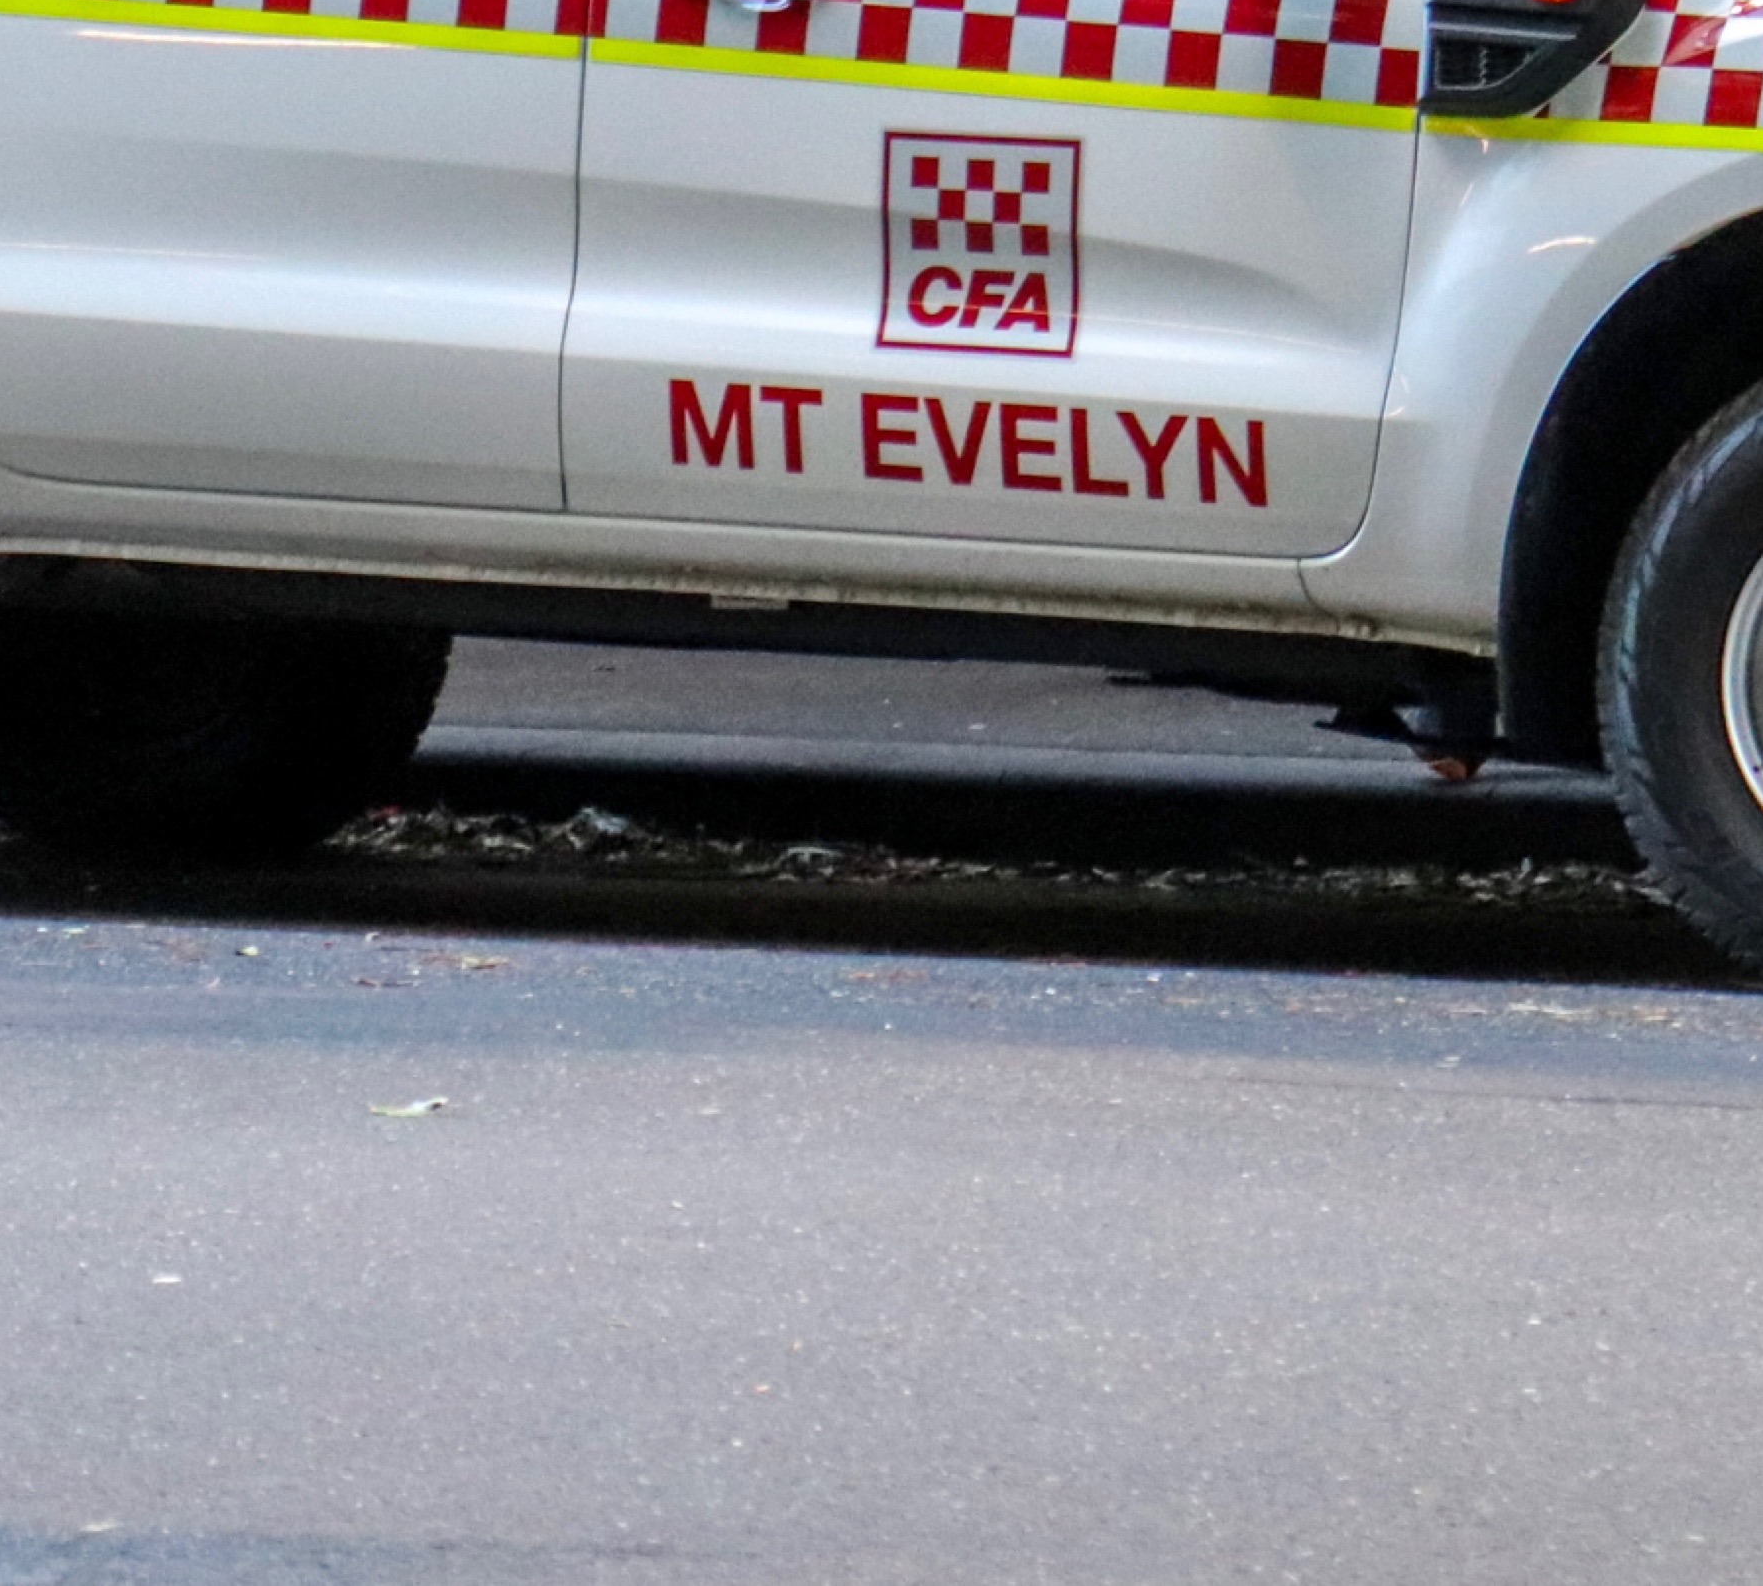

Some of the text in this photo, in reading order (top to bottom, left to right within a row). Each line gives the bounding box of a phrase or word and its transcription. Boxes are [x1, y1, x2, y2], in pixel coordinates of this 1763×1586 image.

[908, 266, 1051, 331] CFA
[670, 379, 1267, 506] MT EVELYN
